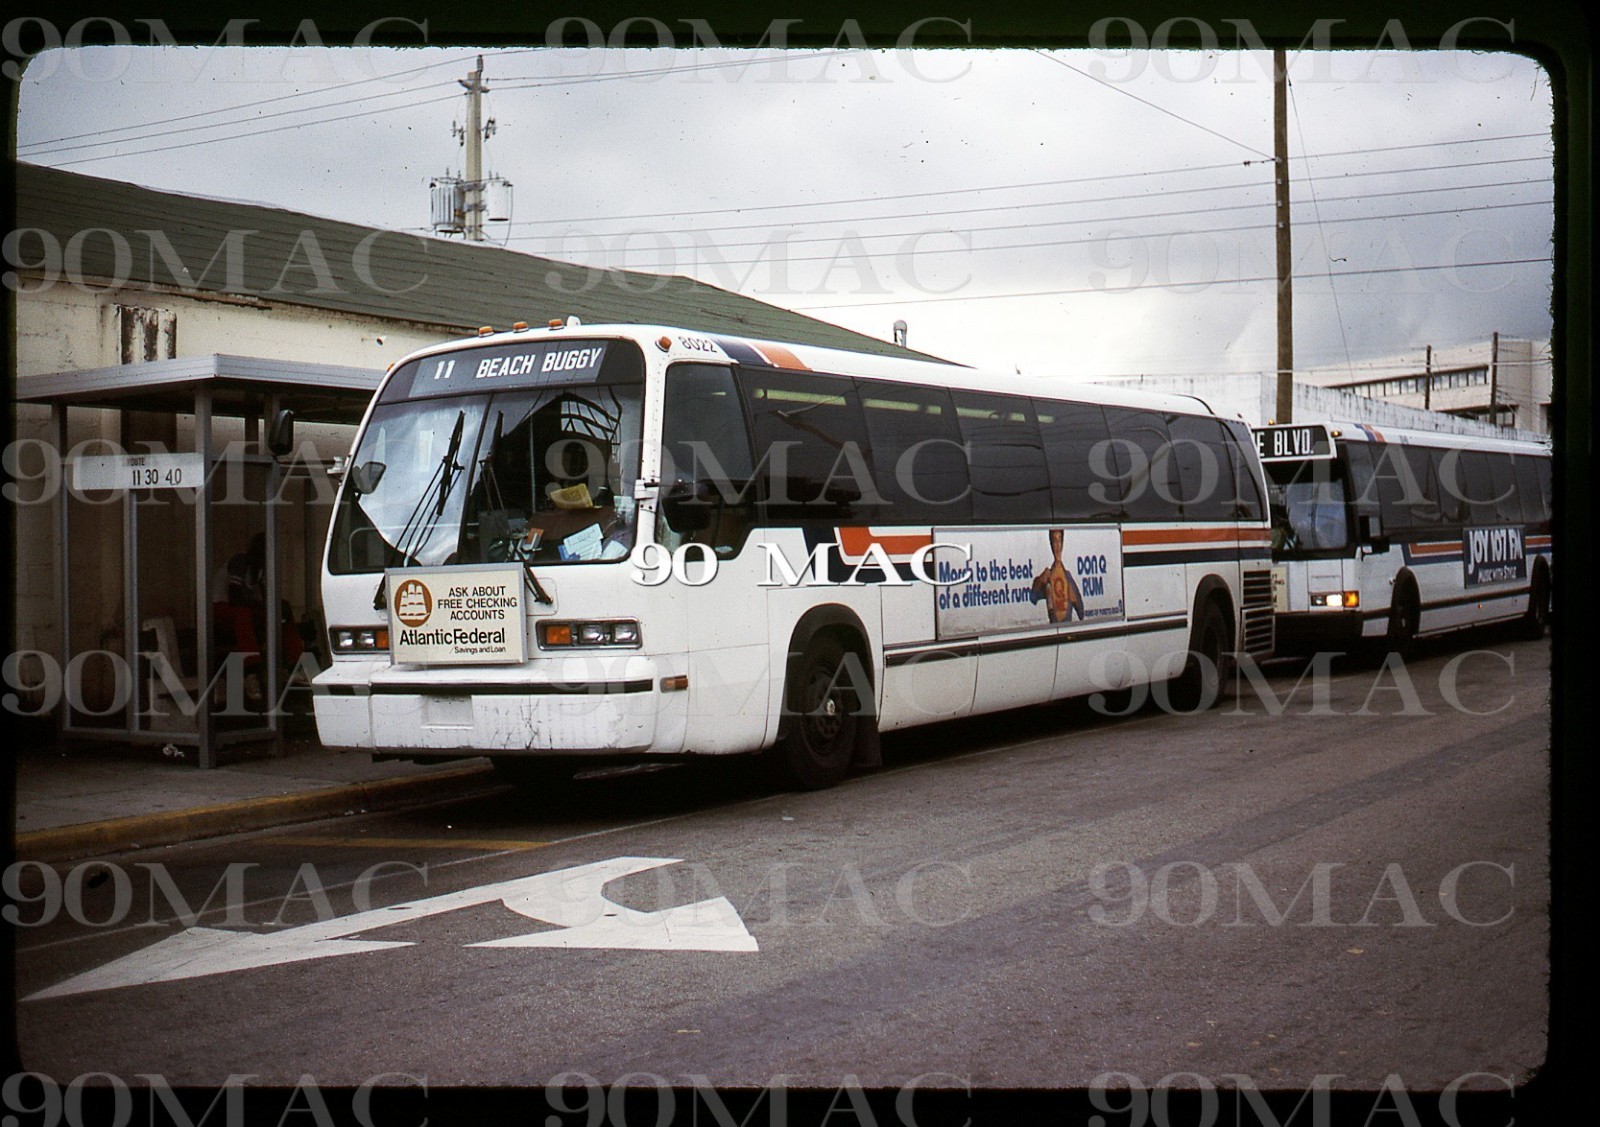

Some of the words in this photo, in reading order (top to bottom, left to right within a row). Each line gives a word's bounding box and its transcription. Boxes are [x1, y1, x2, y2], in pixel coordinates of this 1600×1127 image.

[678, 335, 717, 354] 8022
[434, 360, 455, 379] 11
[475, 354, 534, 379] BEACH
[540, 347, 602, 373] BUGGY
[1273, 429, 1314, 456] BLVD.
[132, 470, 140, 485] 11
[144, 468, 159, 485] 30
[165, 467, 182, 486] 40
[1468, 530, 1489, 574] JOY
[976, 561, 988, 583] to
[989, 558, 1007, 581] the
[1009, 558, 1033, 580] beat
[1077, 556, 1097, 575] DON
[1099, 554, 1107, 574] Q
[449, 587, 468, 597] ASK
[472, 586, 506, 596] ABOUT
[1082, 577, 1104, 597] RUM
[438, 599, 462, 608] FREE
[466, 597, 517, 608] CHECKING
[939, 590, 951, 611] of
[952, 591, 961, 608] a
[963, 584, 1009, 608] different
[450, 609, 505, 620] ACCOUNTS
[455, 646, 478, 655] Savings
